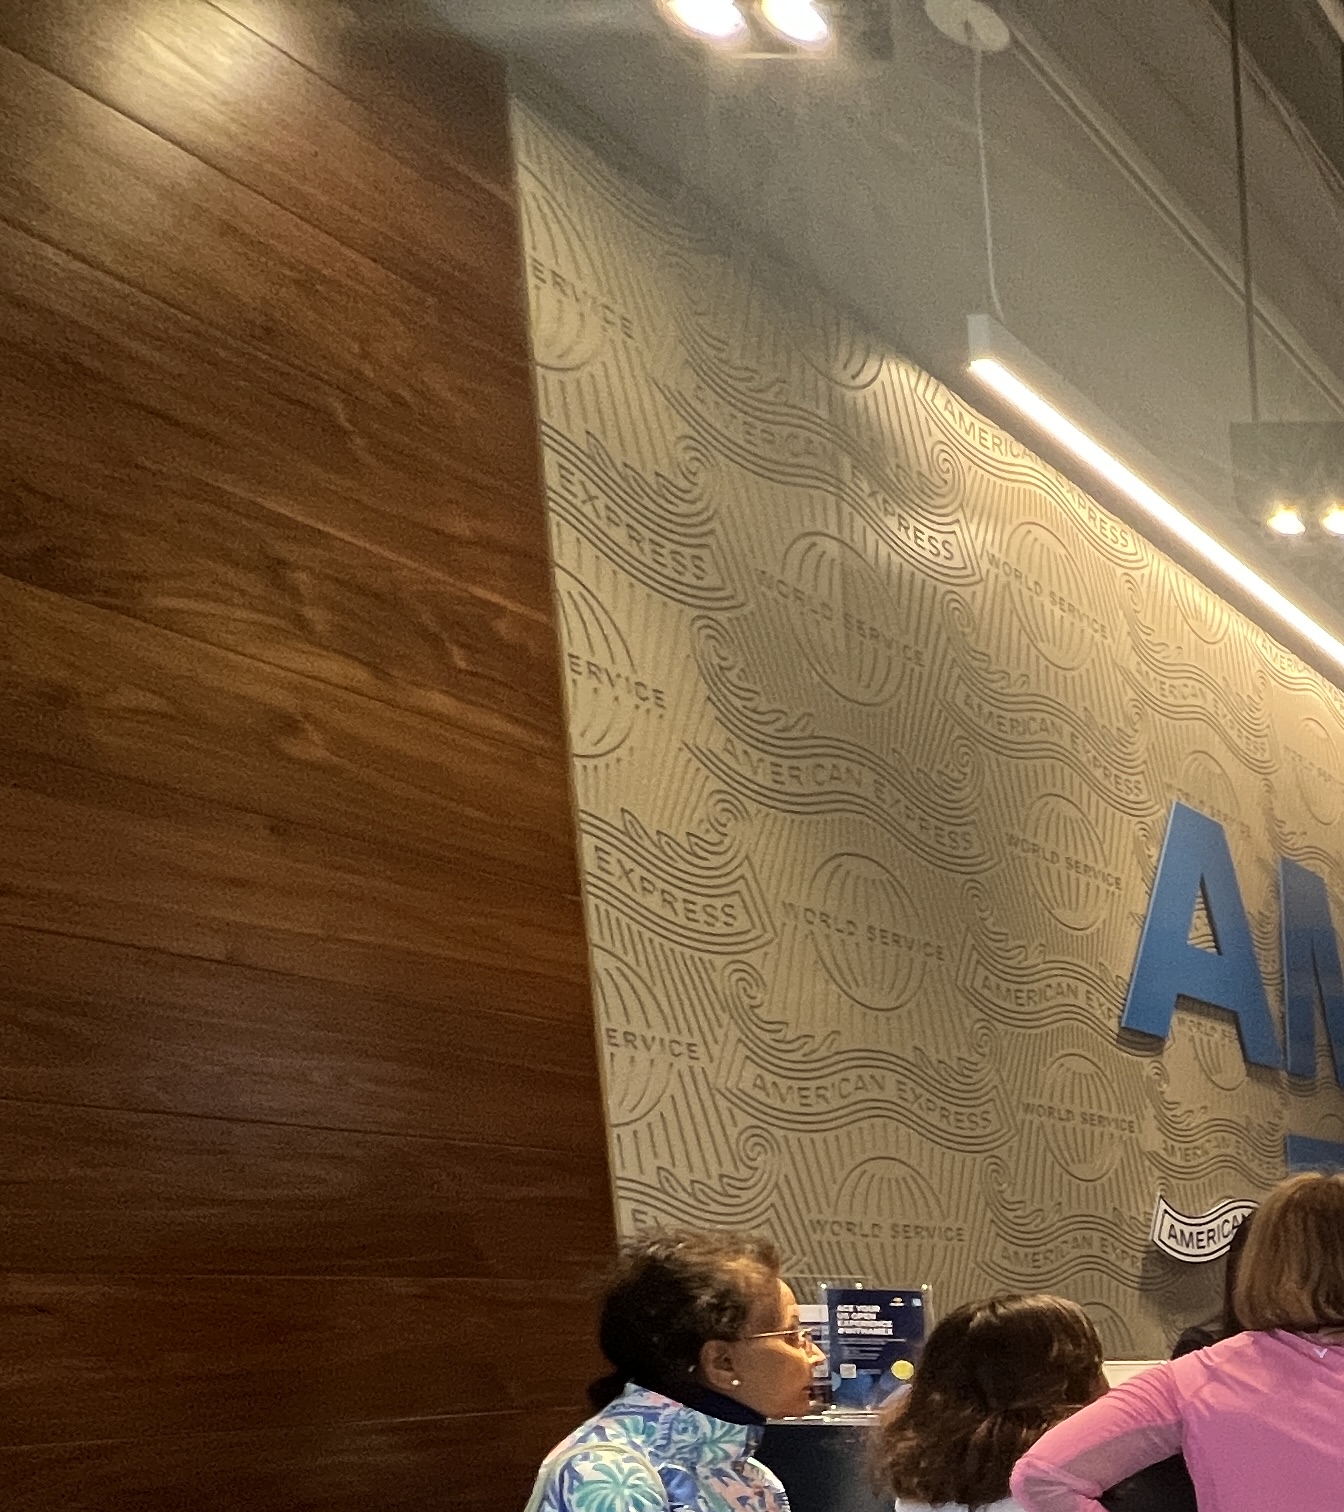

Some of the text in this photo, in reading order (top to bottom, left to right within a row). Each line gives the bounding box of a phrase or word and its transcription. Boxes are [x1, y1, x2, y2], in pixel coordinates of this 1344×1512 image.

[530, 255, 635, 341] ERVICE
[556, 461, 709, 577] EXPRESS
[989, 552, 1108, 640] WORLD SERVICE
[567, 651, 667, 711] ERVICE
[963, 690, 1143, 797] AMERICAN EXPRESS
[723, 736, 974, 852] AMERICAN EXPRESS
[594, 845, 738, 928] EXPRESS
[980, 975, 1079, 1008] AMERICAN
[604, 1026, 702, 1062] ERVICE
[752, 1072, 993, 1133] AMERICAN EXPRESS
[1022, 1102, 1136, 1134] WORLD SERVICE
[808, 1218, 967, 1243] WORLD SERVICE
